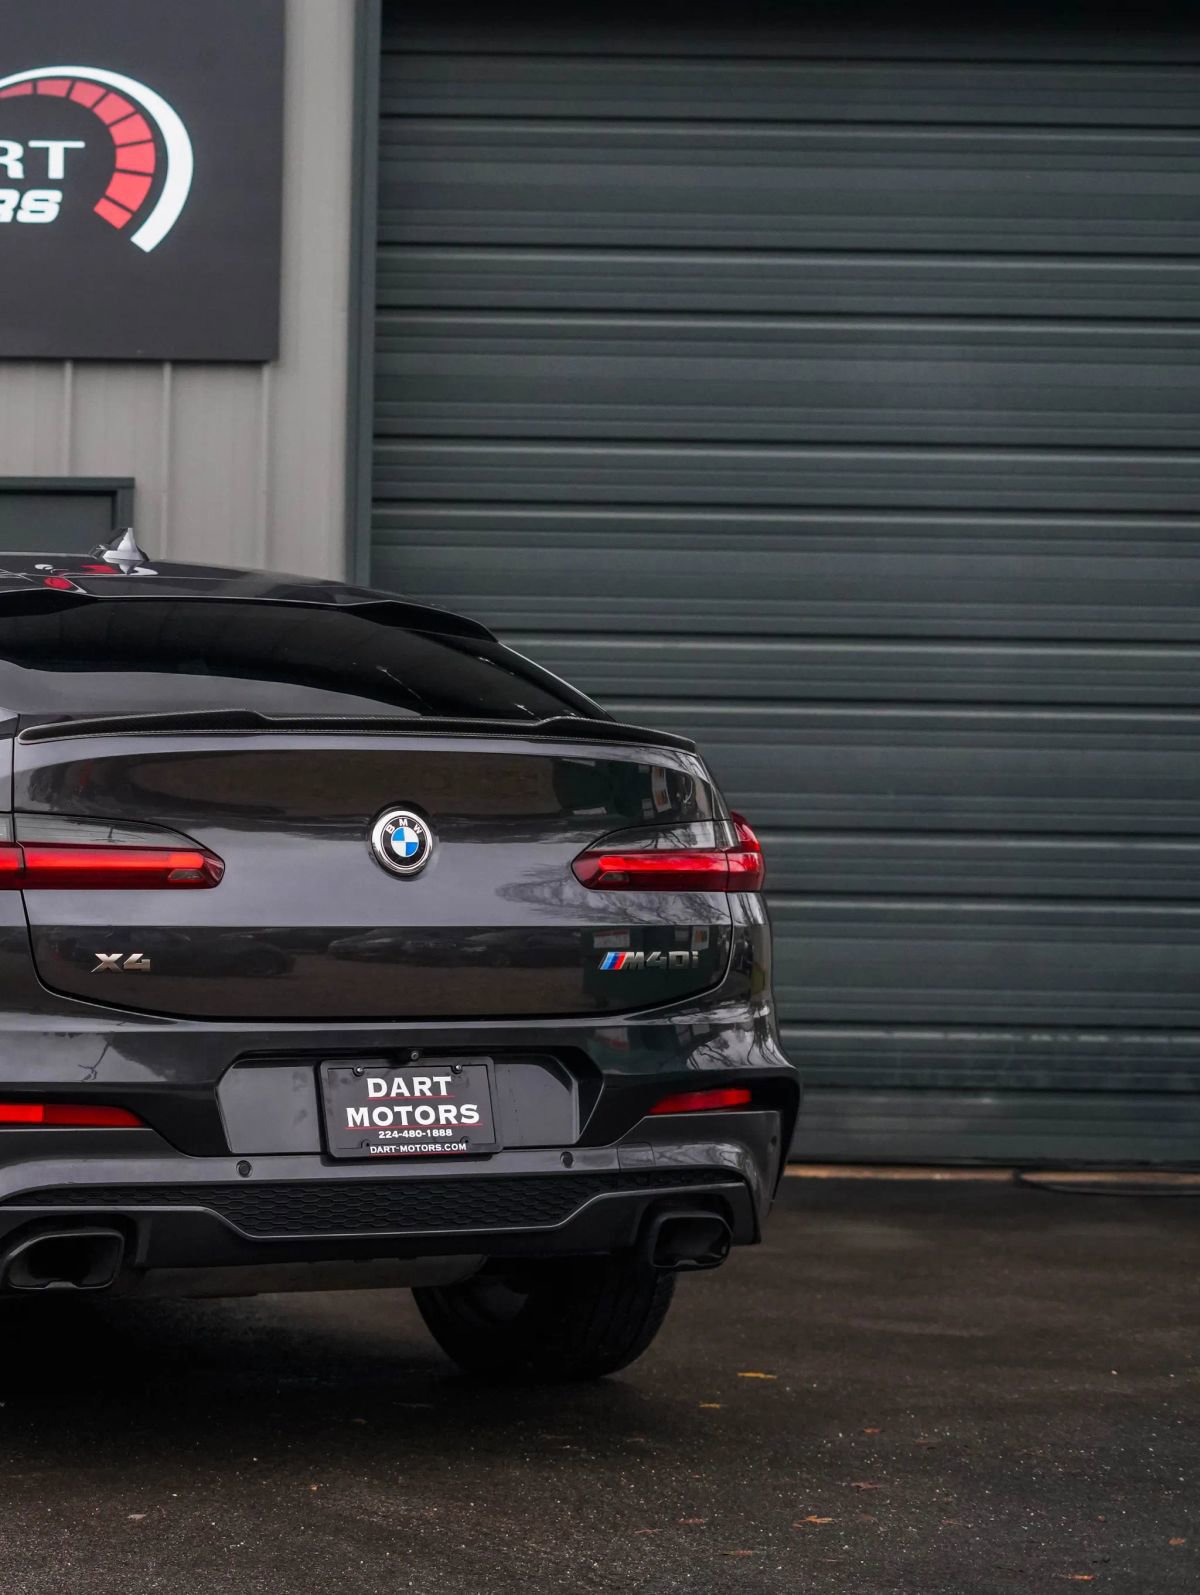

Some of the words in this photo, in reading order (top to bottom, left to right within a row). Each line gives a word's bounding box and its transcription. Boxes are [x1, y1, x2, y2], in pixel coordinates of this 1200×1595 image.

[385, 818, 424, 835] BMW
[90, 952, 152, 972] X4
[621, 950, 700, 969] M40i
[367, 1076, 452, 1098] DART
[346, 1104, 480, 1128] MOTORS
[378, 1128, 453, 1139] 224-480-1888
[370, 1143, 467, 1154] DART-MOTORS.COM
